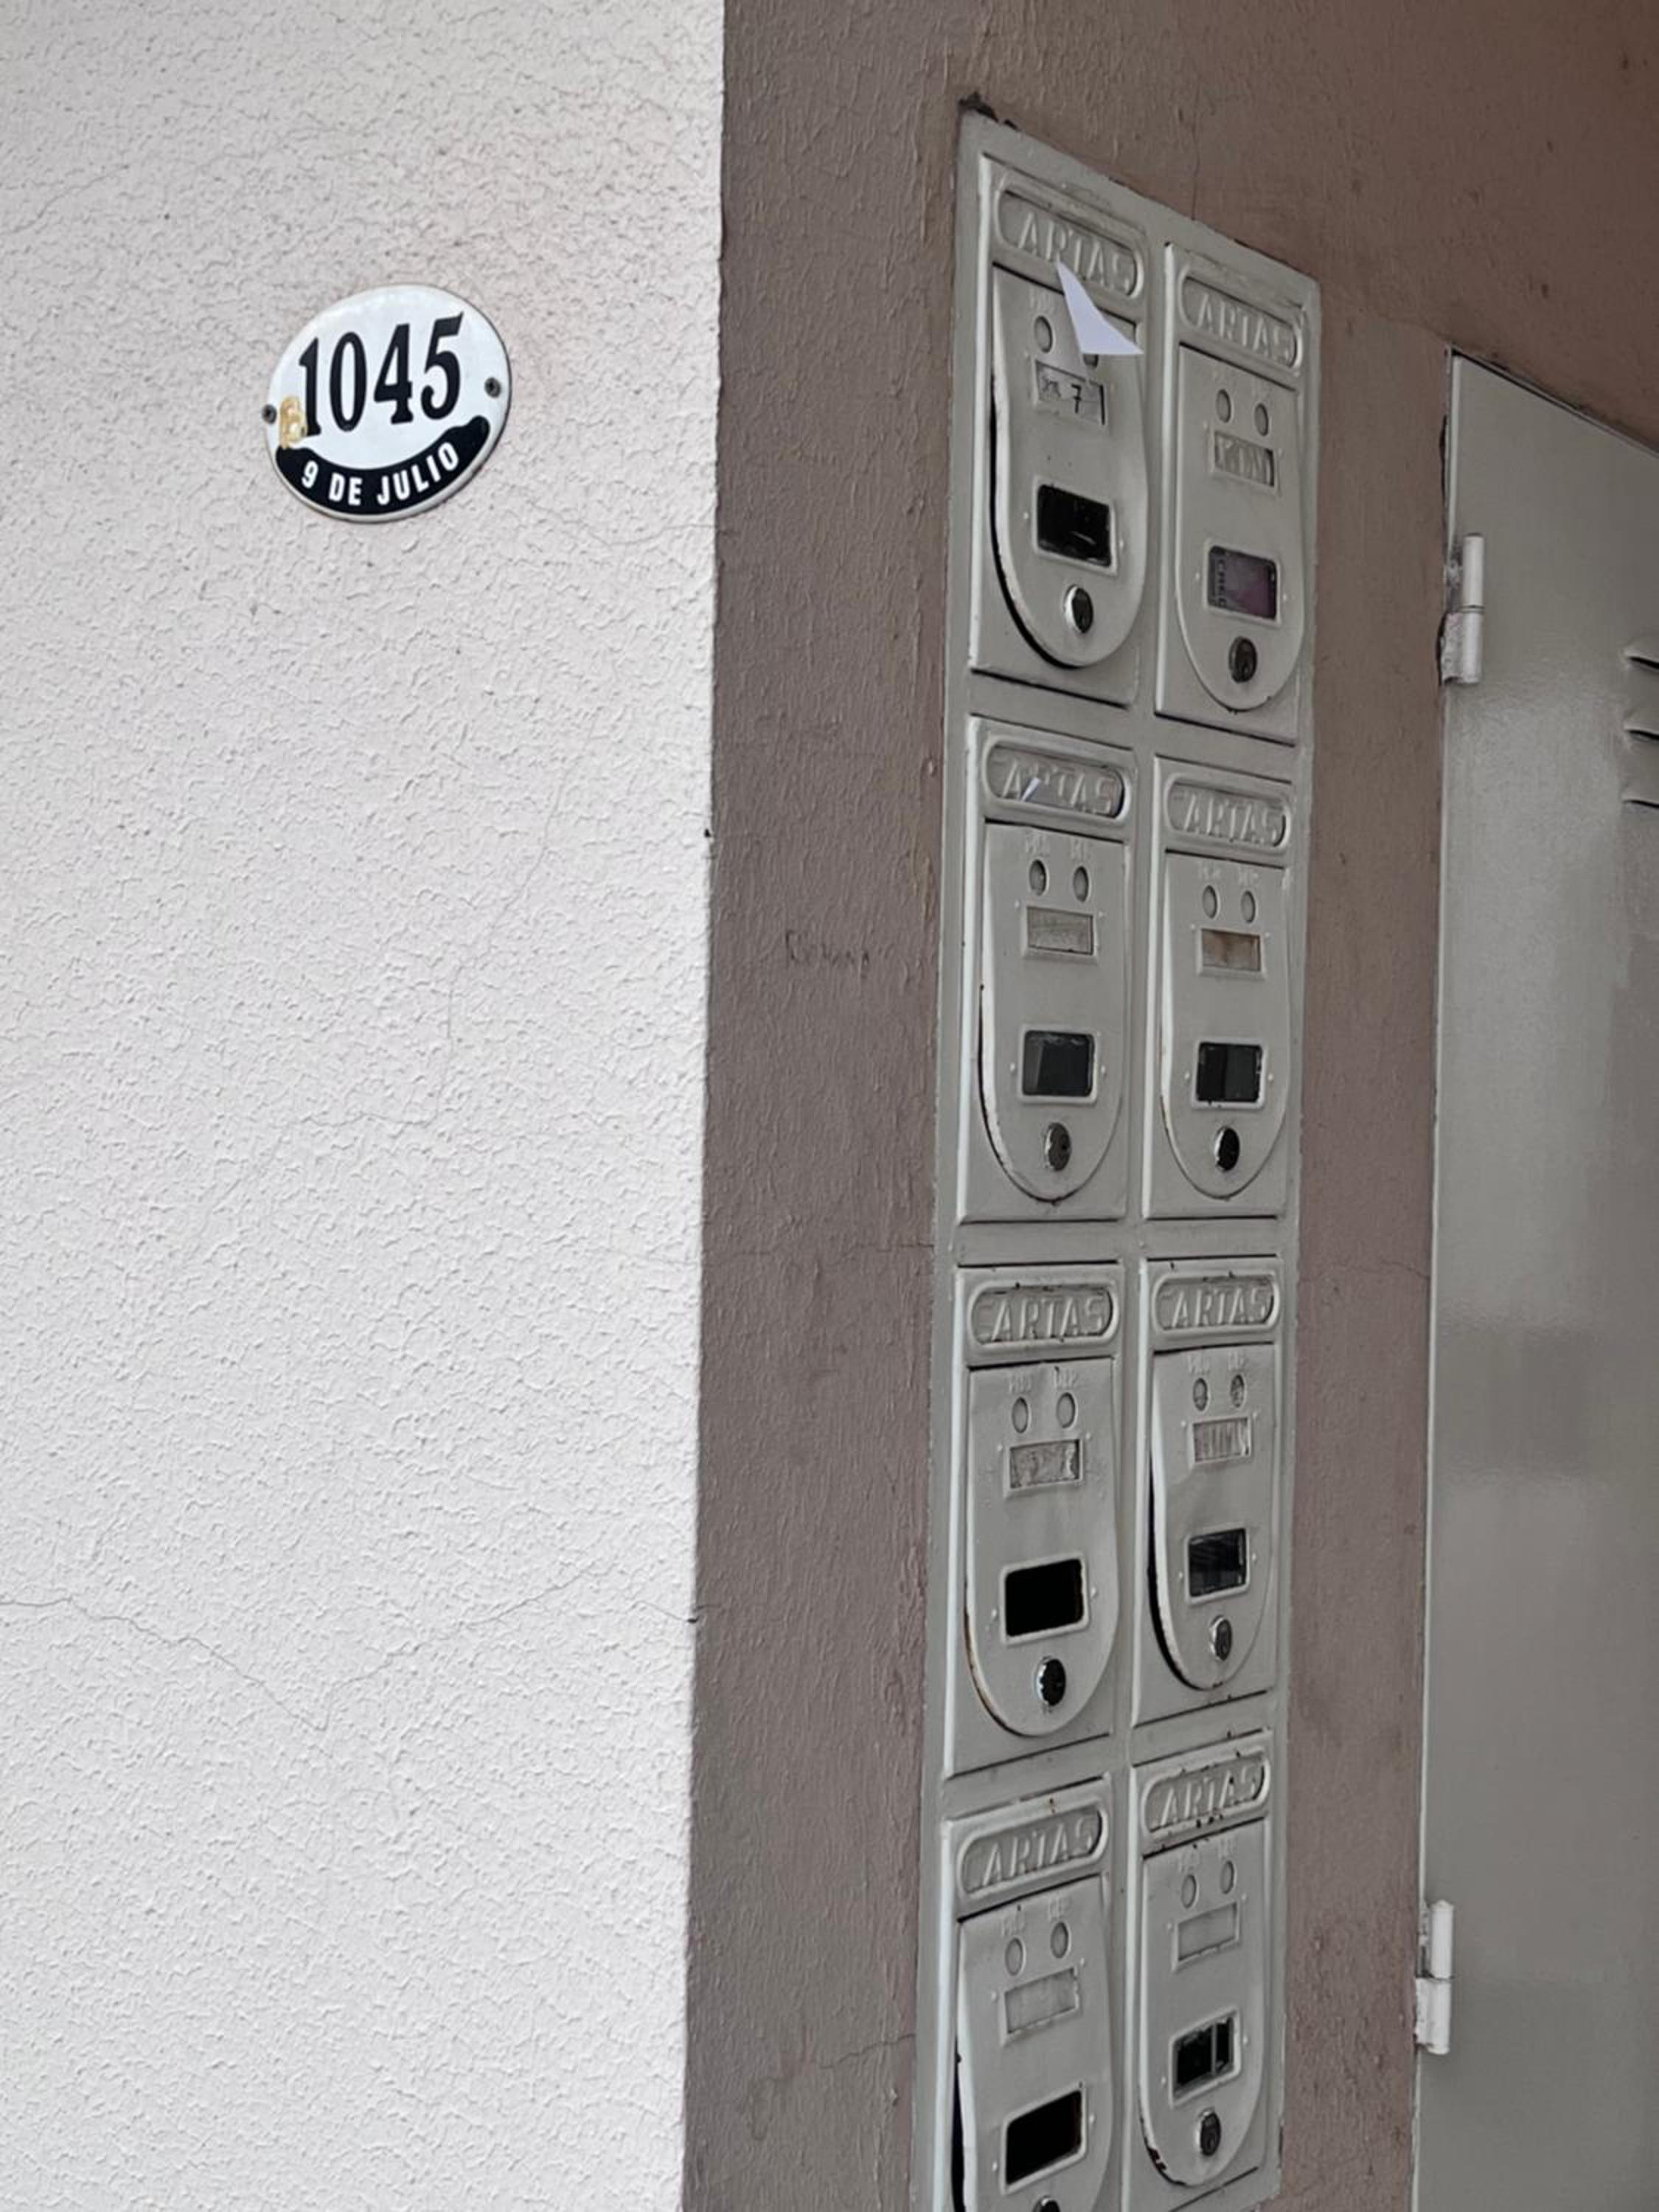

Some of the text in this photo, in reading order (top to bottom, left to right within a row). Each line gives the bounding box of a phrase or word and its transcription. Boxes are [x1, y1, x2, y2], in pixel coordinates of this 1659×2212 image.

[299, 311, 464, 437] 1045
[302, 442, 459, 505] 9 DE JULIO
